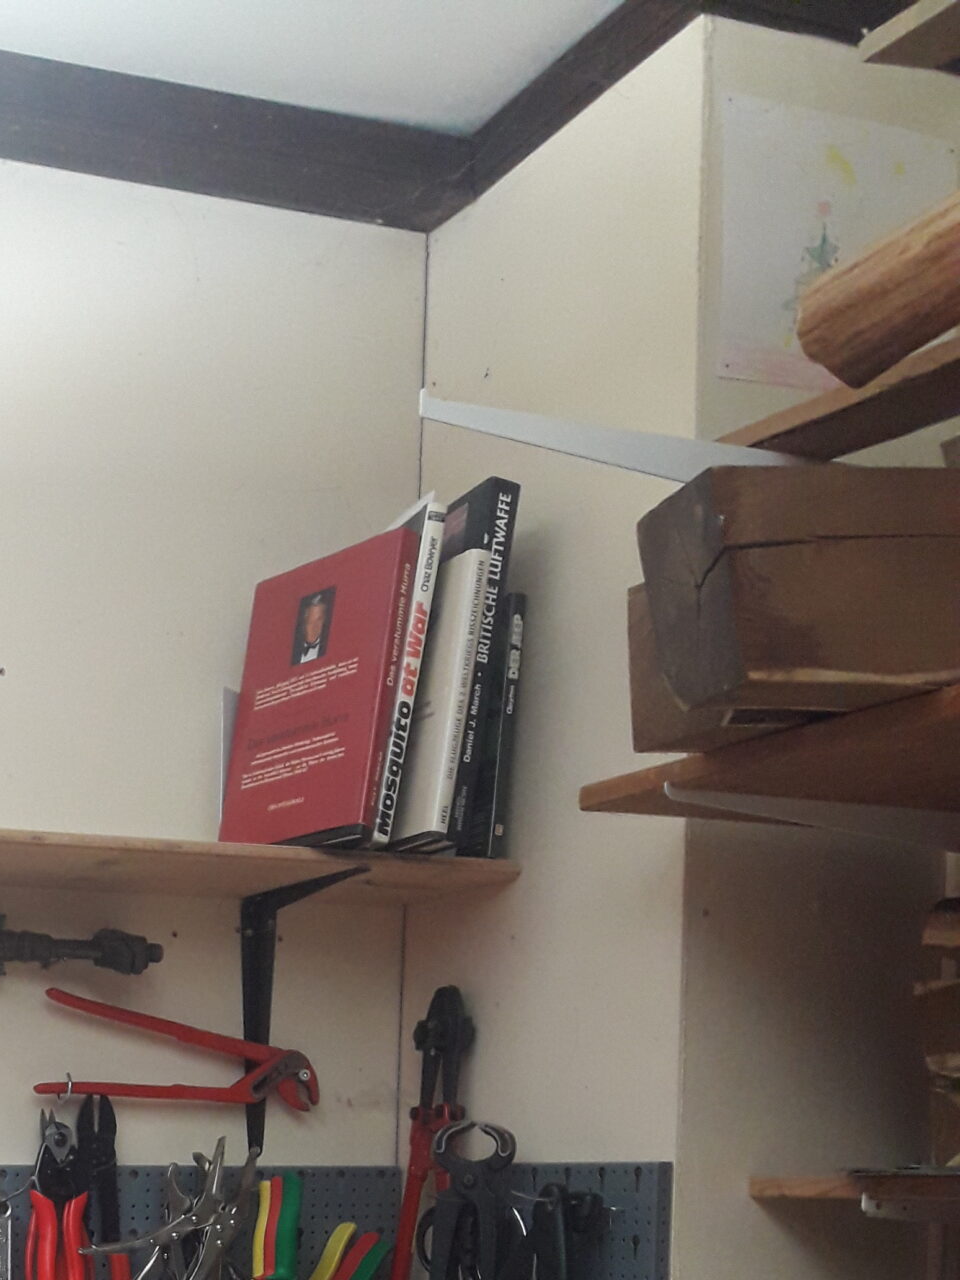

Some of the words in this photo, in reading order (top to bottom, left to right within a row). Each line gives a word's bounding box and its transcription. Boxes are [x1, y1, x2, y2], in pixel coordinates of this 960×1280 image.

[488, 492, 512, 580] LUFTWAFFE
[386, 664, 396, 686] Das
[401, 563, 411, 594] Hurra
[401, 662, 417, 696] at
[425, 536, 438, 571] Bowyer
[477, 586, 498, 664] BRITISCHE
[468, 719, 477, 728] J.
[470, 683, 482, 715] March
[463, 730, 474, 763] Daniel
